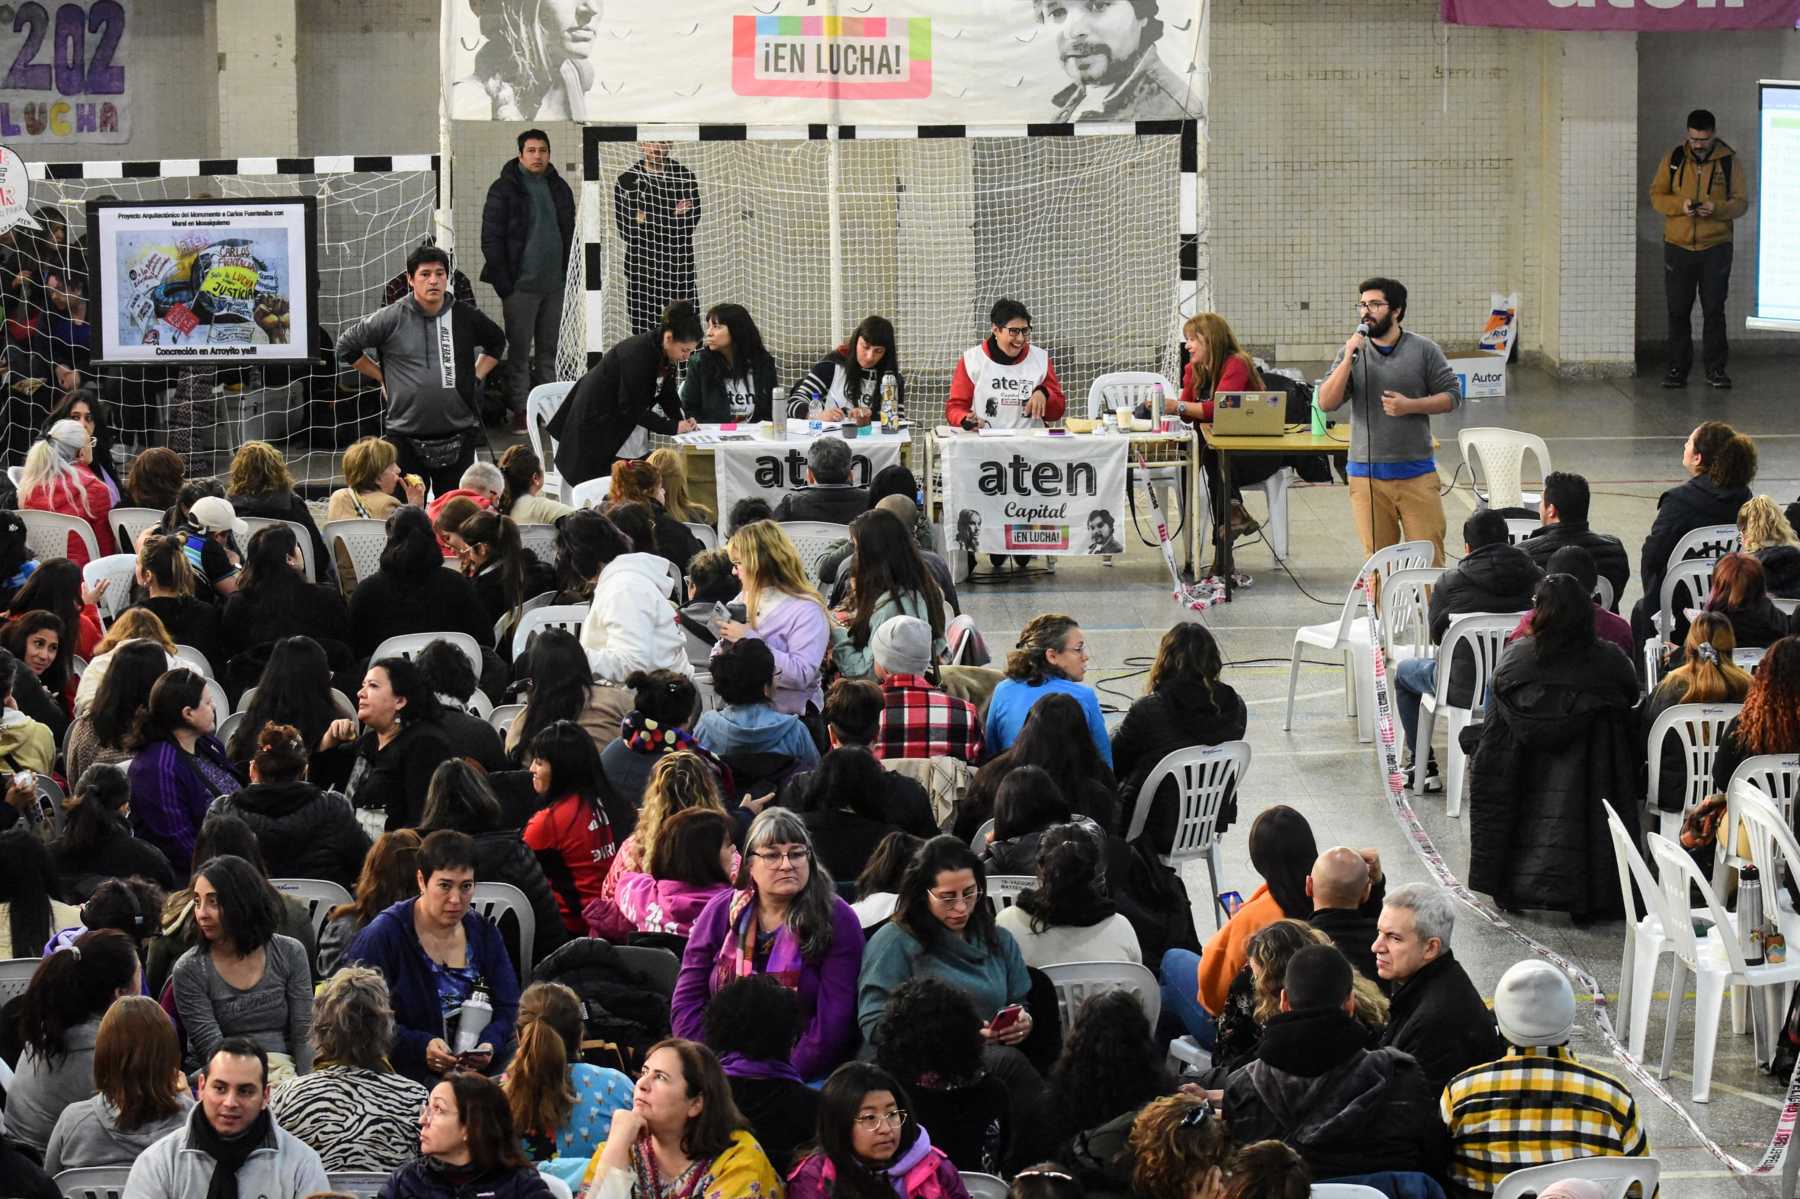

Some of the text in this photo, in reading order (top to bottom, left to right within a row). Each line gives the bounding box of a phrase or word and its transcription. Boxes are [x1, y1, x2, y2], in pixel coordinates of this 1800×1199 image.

[1, 0, 125, 96] 202
[764, 43, 901, 75] ¡EN LUCHA!
[0, 101, 119, 137] LUCHA
[226, 209, 243, 217] Carlos
[155, 345, 198, 356] Concreción
[199, 347, 209, 356] en
[209, 345, 240, 357] Arroyito
[991, 376, 1019, 391] ate
[1472, 372, 1503, 383] Autor
[754, 448, 873, 488] atn
[978, 454, 1097, 497] aten
[1004, 501, 1067, 523] Capital
[1013, 530, 1059, 543] ¡EN LUCHA!
